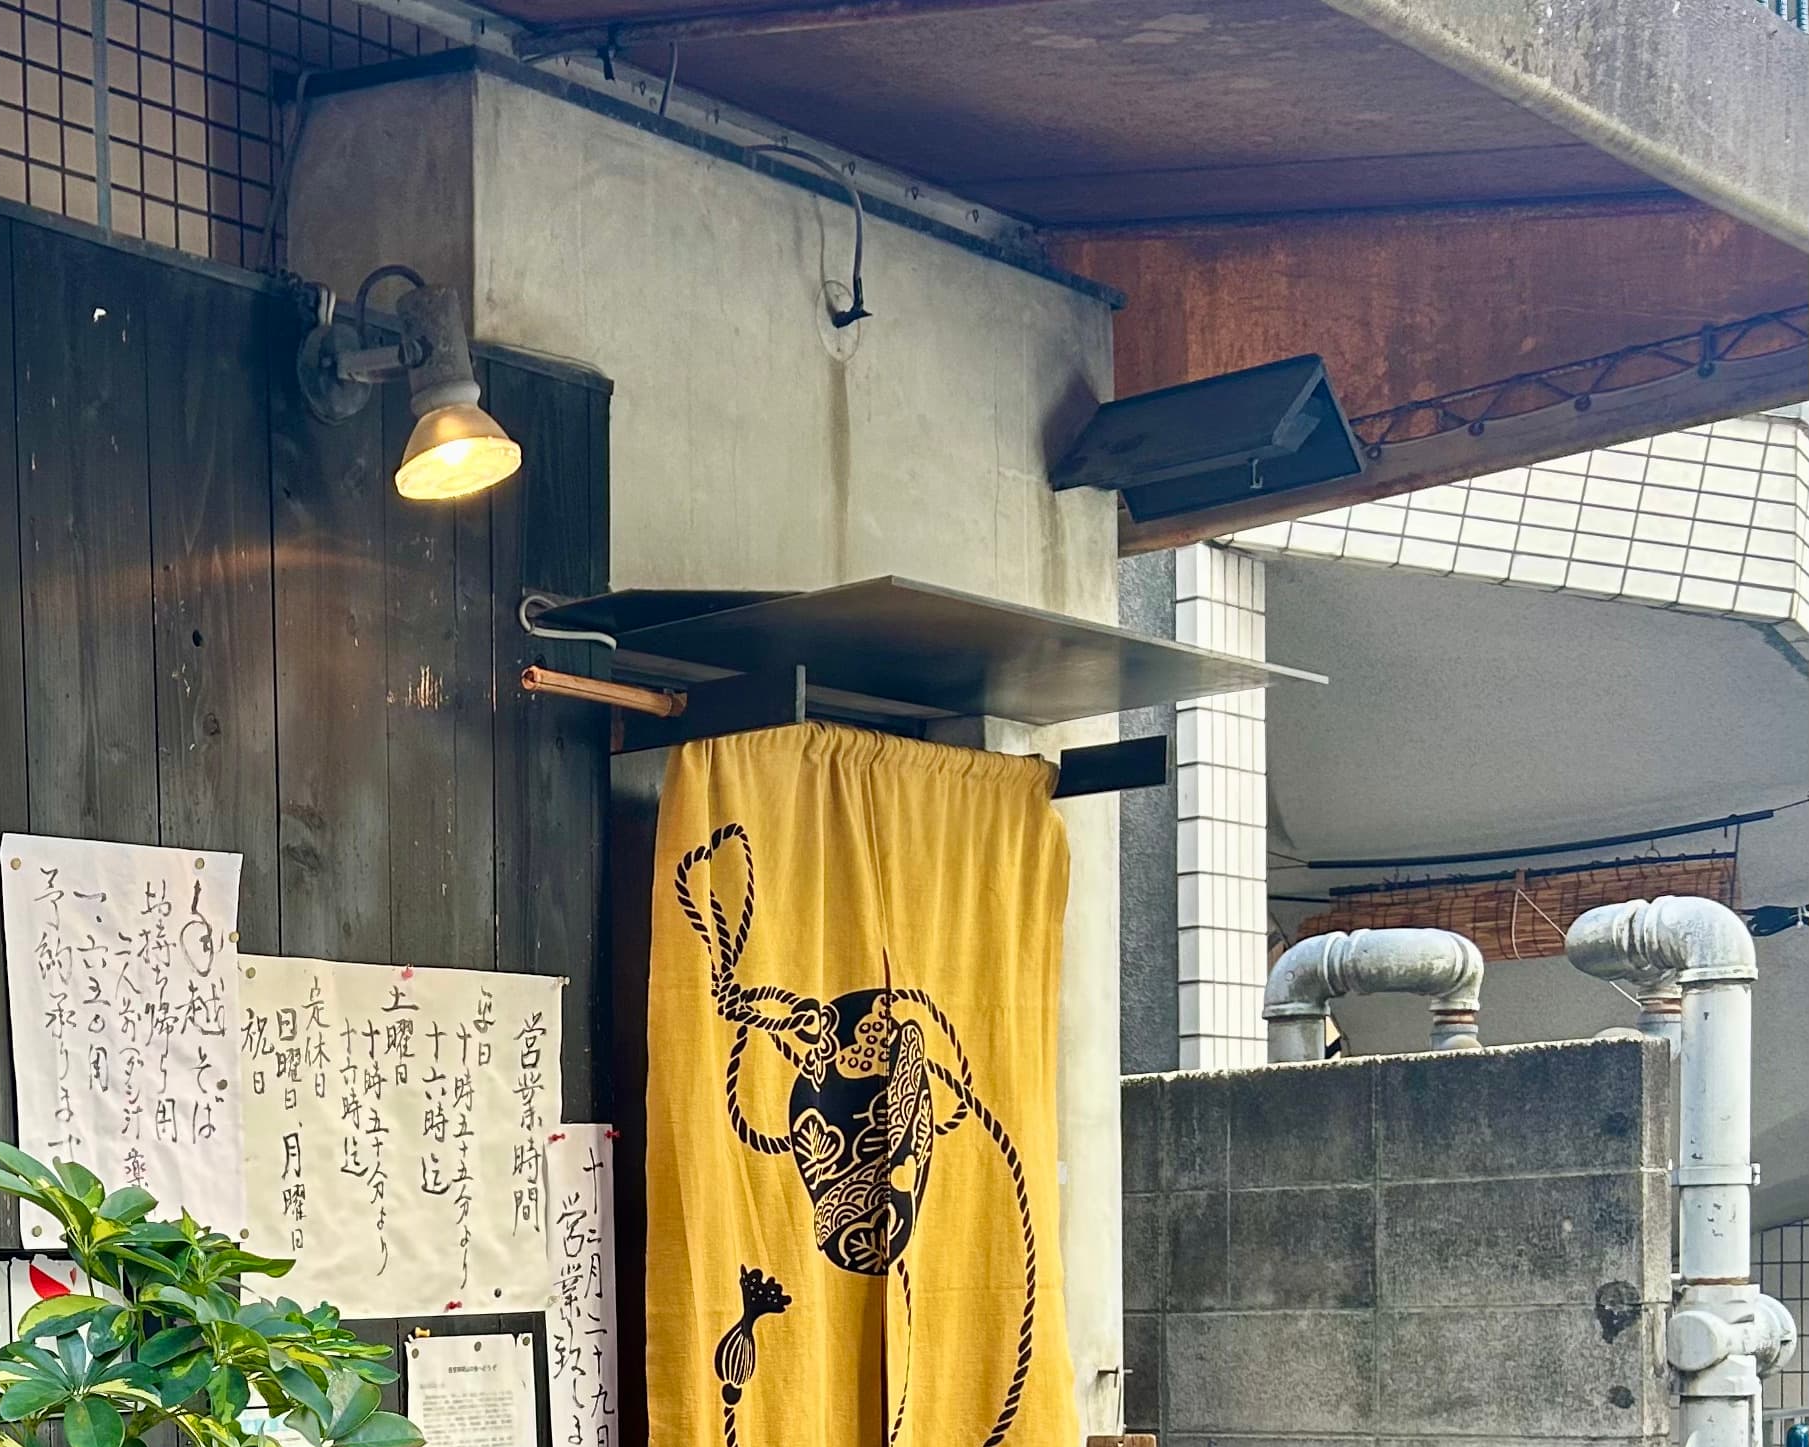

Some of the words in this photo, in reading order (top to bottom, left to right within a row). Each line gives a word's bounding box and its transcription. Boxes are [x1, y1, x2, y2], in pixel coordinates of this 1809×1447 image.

[241, 1008, 274, 1095] 祝日
[302, 976, 330, 1098] 定休日
[382, 985, 420, 1086] 土曜日
[512, 1011, 547, 1237] 営業時間
